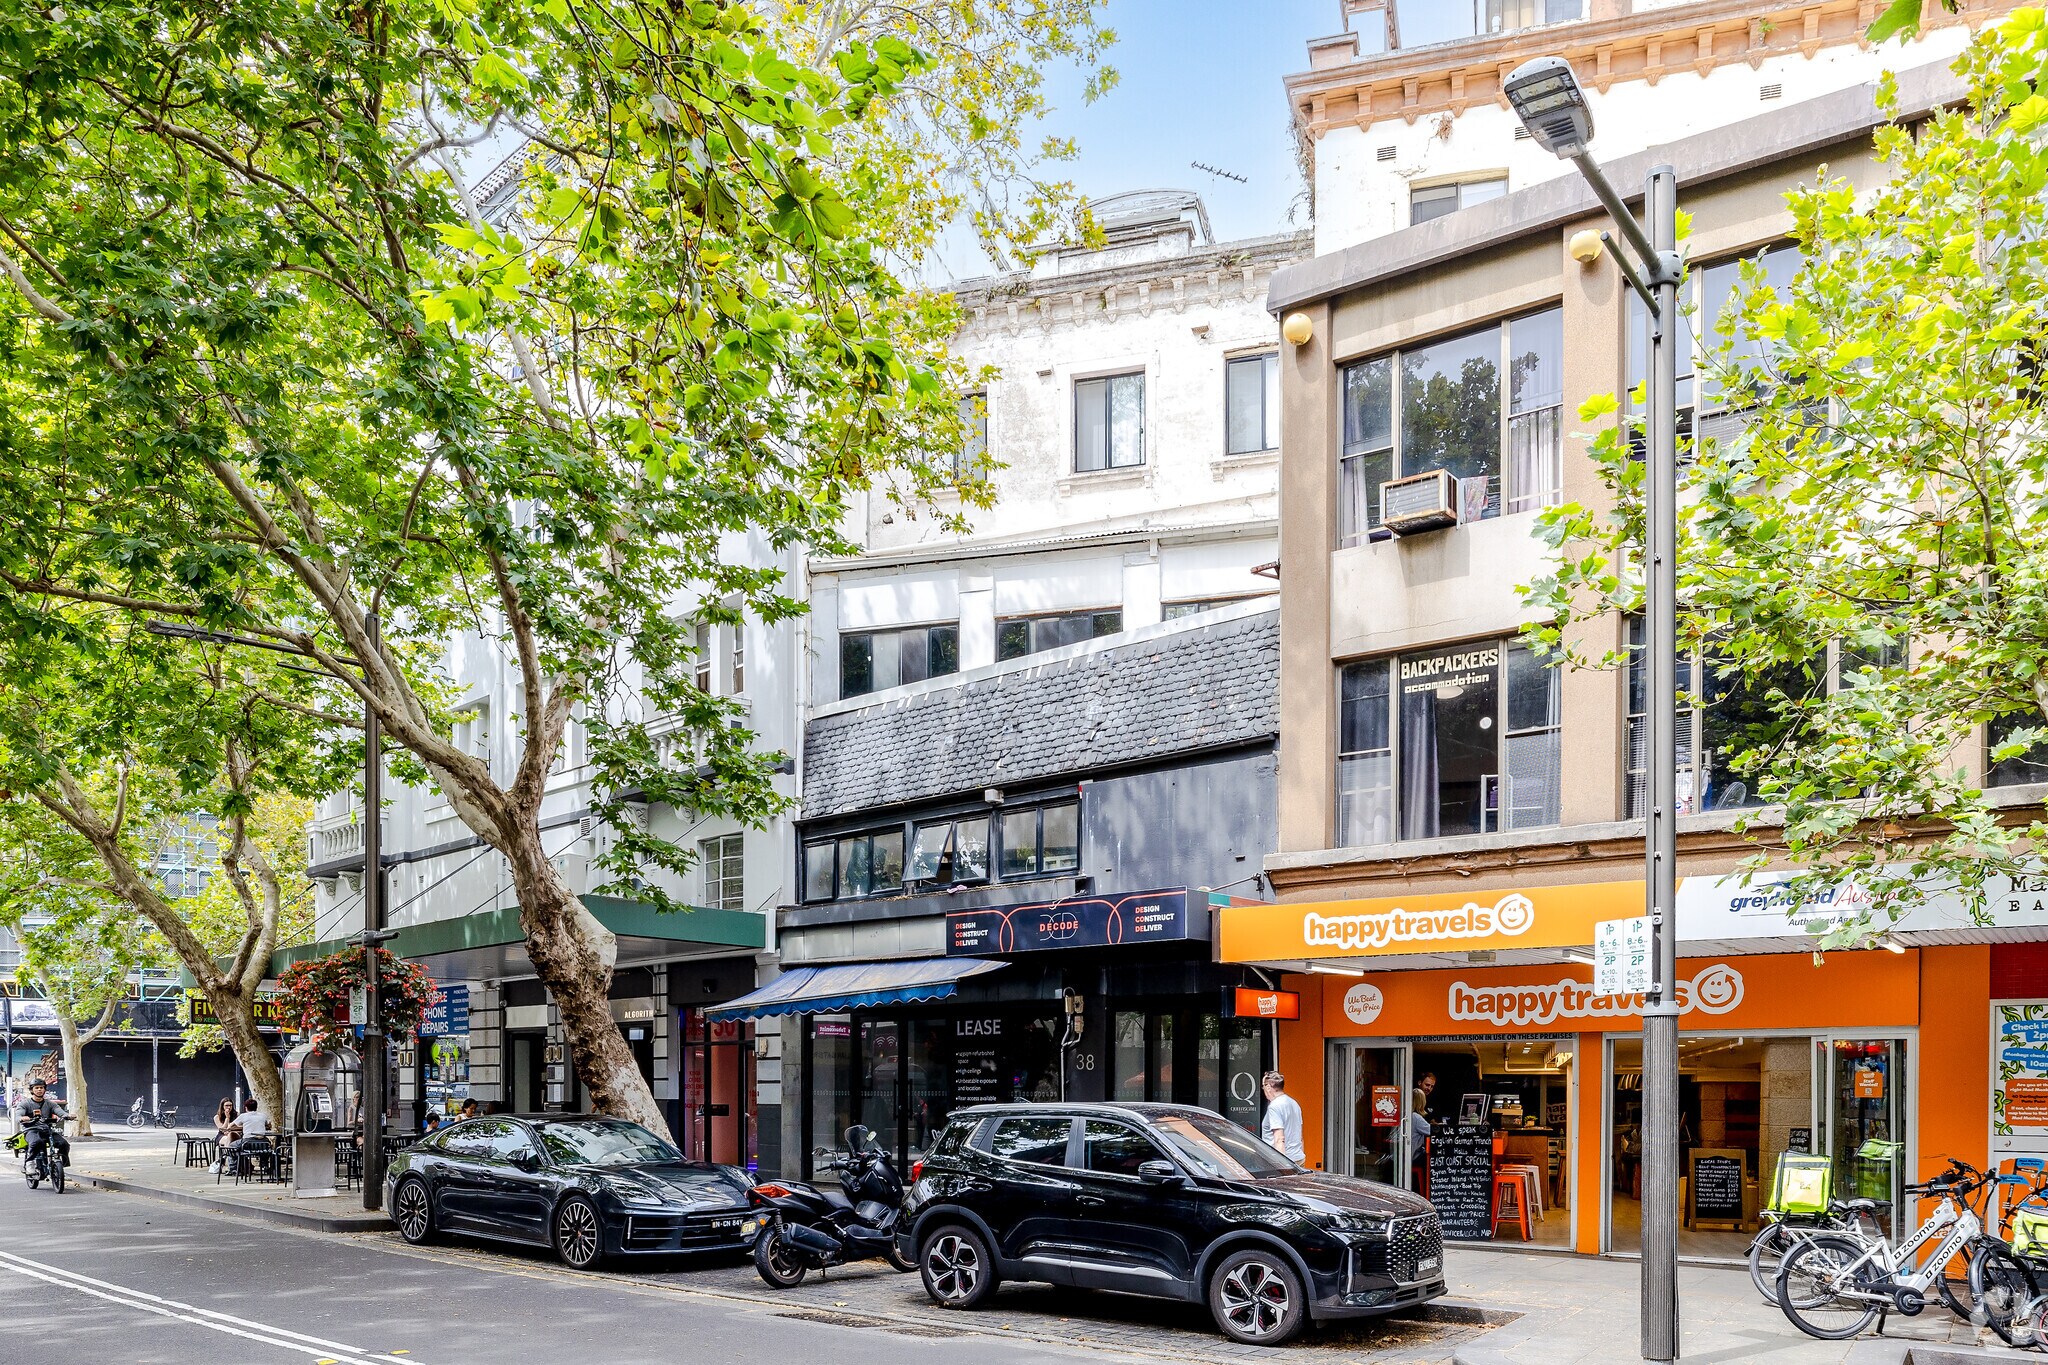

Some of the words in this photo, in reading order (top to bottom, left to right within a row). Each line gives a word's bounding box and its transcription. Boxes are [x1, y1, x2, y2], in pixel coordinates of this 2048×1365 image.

[1401, 648, 1498, 679] BACKPACKERS
[1135, 905, 1160, 914] DESIGN
[1135, 913, 1174, 923] CONSTRUCT
[955, 922, 976, 930] DESIGN
[1040, 921, 1079, 932] DECODE
[1135, 924, 1162, 933] DELIVER
[1309, 918, 1390, 943] happy
[1392, 909, 1491, 935] travels
[1606, 926, 1614, 935] 1P
[1633, 922, 1642, 932] 1P
[955, 930, 988, 938] CONSTRUCT
[955, 939, 978, 947] DELIVER
[1604, 956, 1616, 965] 2P
[1631, 955, 1644, 965] 2P
[1348, 996, 1360, 1004] We
[1360, 993, 1376, 1002] Beat
[1455, 988, 1557, 1019] happy
[424, 1006, 447, 1018] PHONE
[1348, 1005, 1361, 1015] Any
[1363, 1003, 1380, 1012] Price
[421, 1021, 449, 1034] REPAIRS
[957, 1019, 1001, 1035] LEASE
[2011, 1023, 2039, 1031] Check
[1076, 1054, 1095, 1070] 38
[1231, 1072, 1256, 1106] Q
[1430, 1157, 1445, 1166] EAST
[1446, 1156, 1462, 1166] COAST
[1465, 1156, 1491, 1166] SPECIAL
[1902, 1222, 1935, 1252] zoomo
[1932, 1236, 1962, 1271] zoomo
